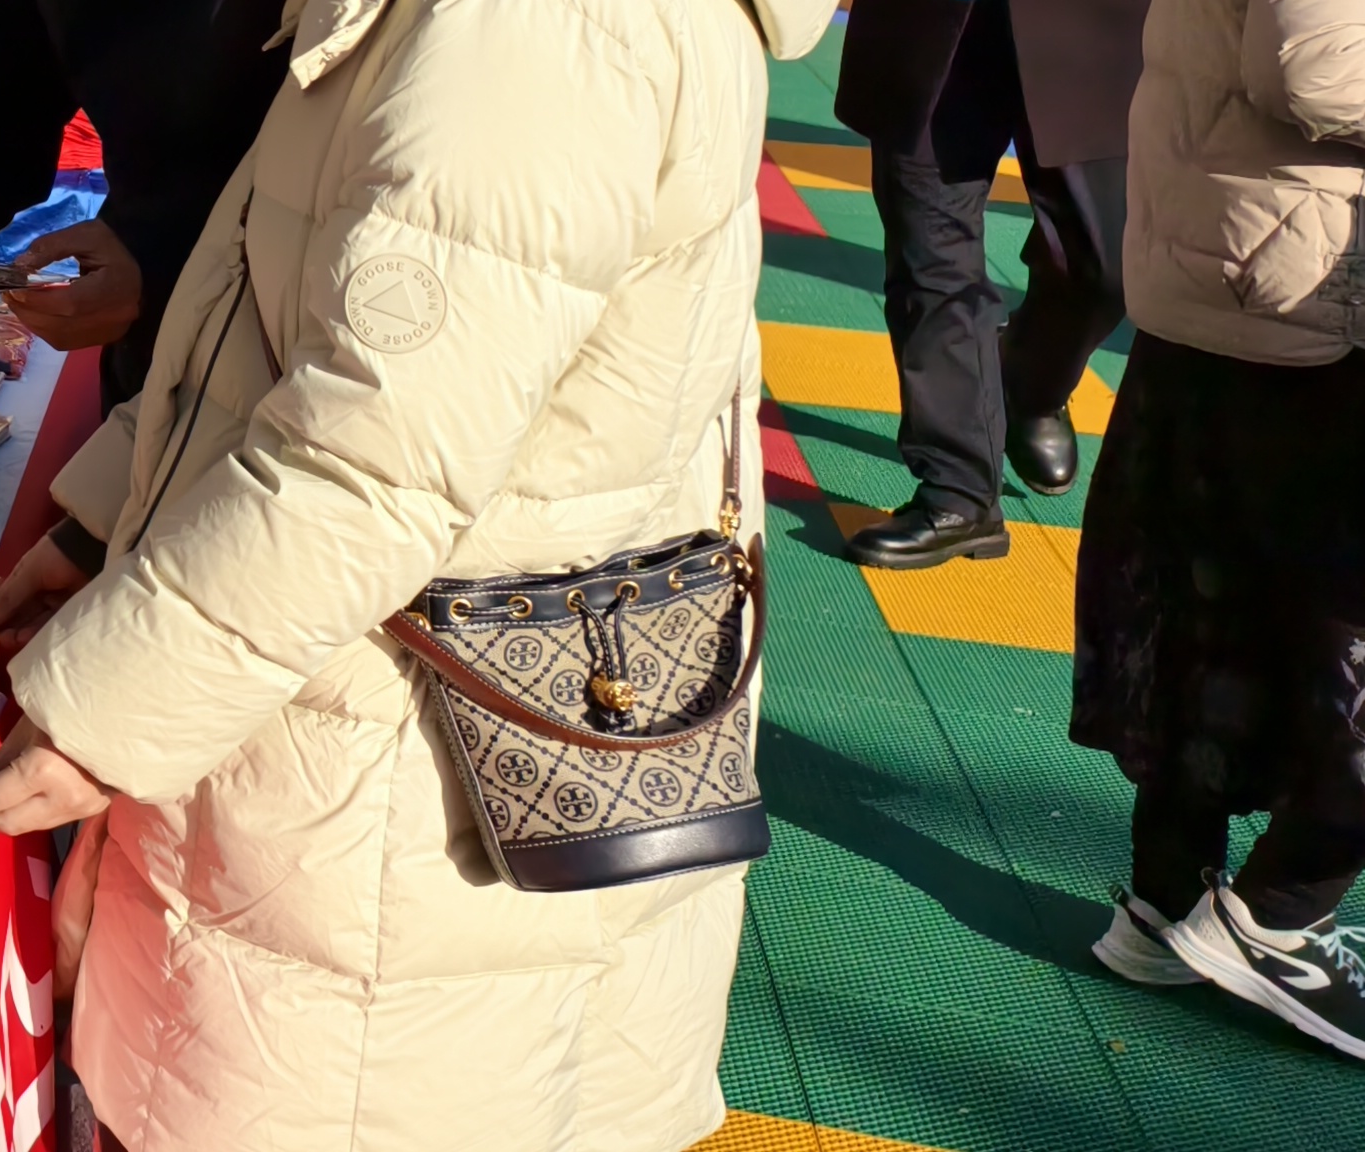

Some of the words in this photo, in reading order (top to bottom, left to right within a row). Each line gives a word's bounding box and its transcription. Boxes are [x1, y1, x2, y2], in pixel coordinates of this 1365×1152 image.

[357, 261, 405, 286] GOOSE
[413, 270, 439, 311] DOWN
[350, 296, 374, 337] DOWN
